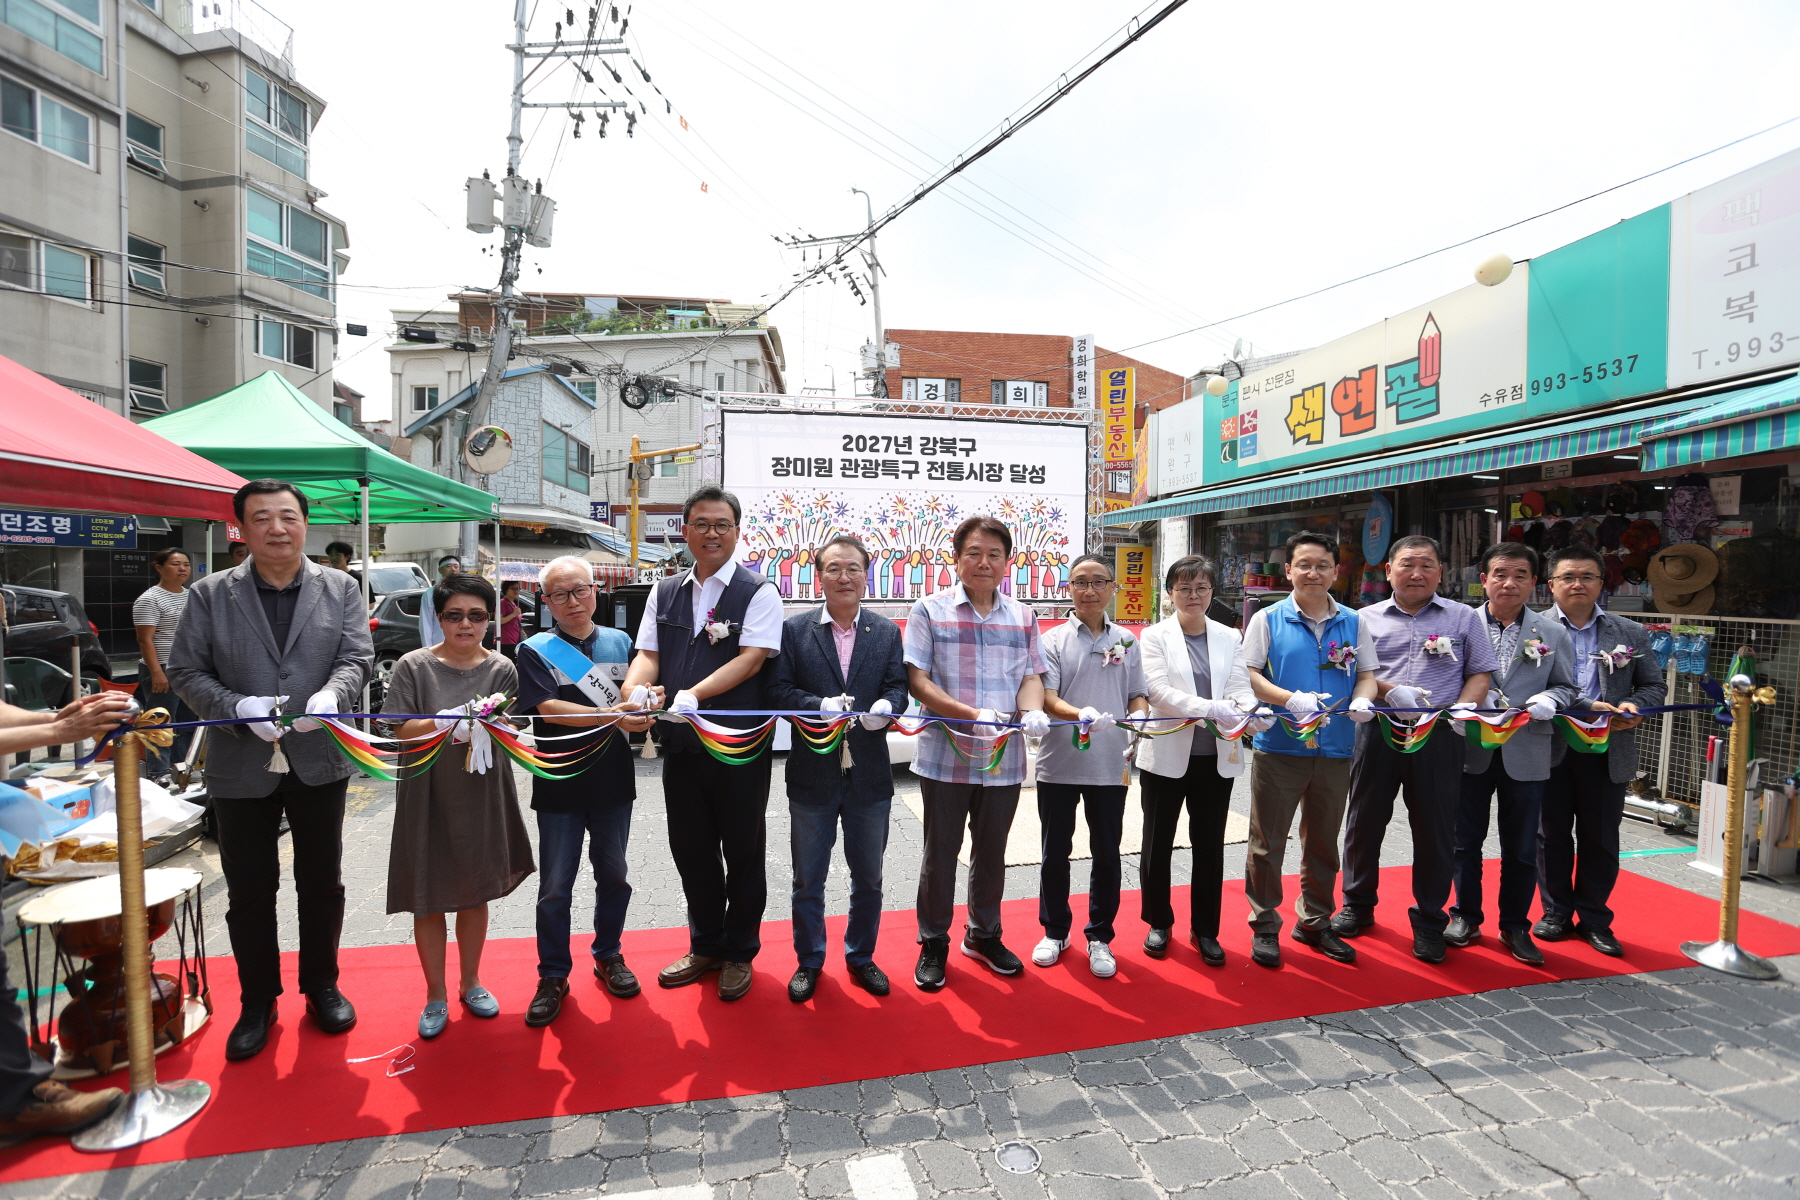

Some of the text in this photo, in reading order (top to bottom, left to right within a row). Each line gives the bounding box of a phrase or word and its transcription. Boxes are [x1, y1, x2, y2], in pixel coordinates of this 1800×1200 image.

[1723, 242, 1759, 277] 코
[1722, 290, 1759, 323] 복
[1077, 338, 1087, 400] 경희학원
[1284, 312, 1441, 446] 색연필
[1479, 353, 1639, 408] 수유점 993-5537
[924, 383, 938, 400] 경
[1012, 386, 1027, 403] 희
[1108, 370, 1128, 459] 열린부동산
[841, 434, 977, 459] 2027년 강북구
[771, 456, 1046, 484] 장미원 관광특구 전통시장 달성
[1105, 461, 1133, 470] 00-5565
[1544, 464, 1569, 479] 문구
[0, 513, 71, 535] 던조명
[643, 569, 664, 582] 생선
[1124, 551, 1144, 616] 열린부동산
